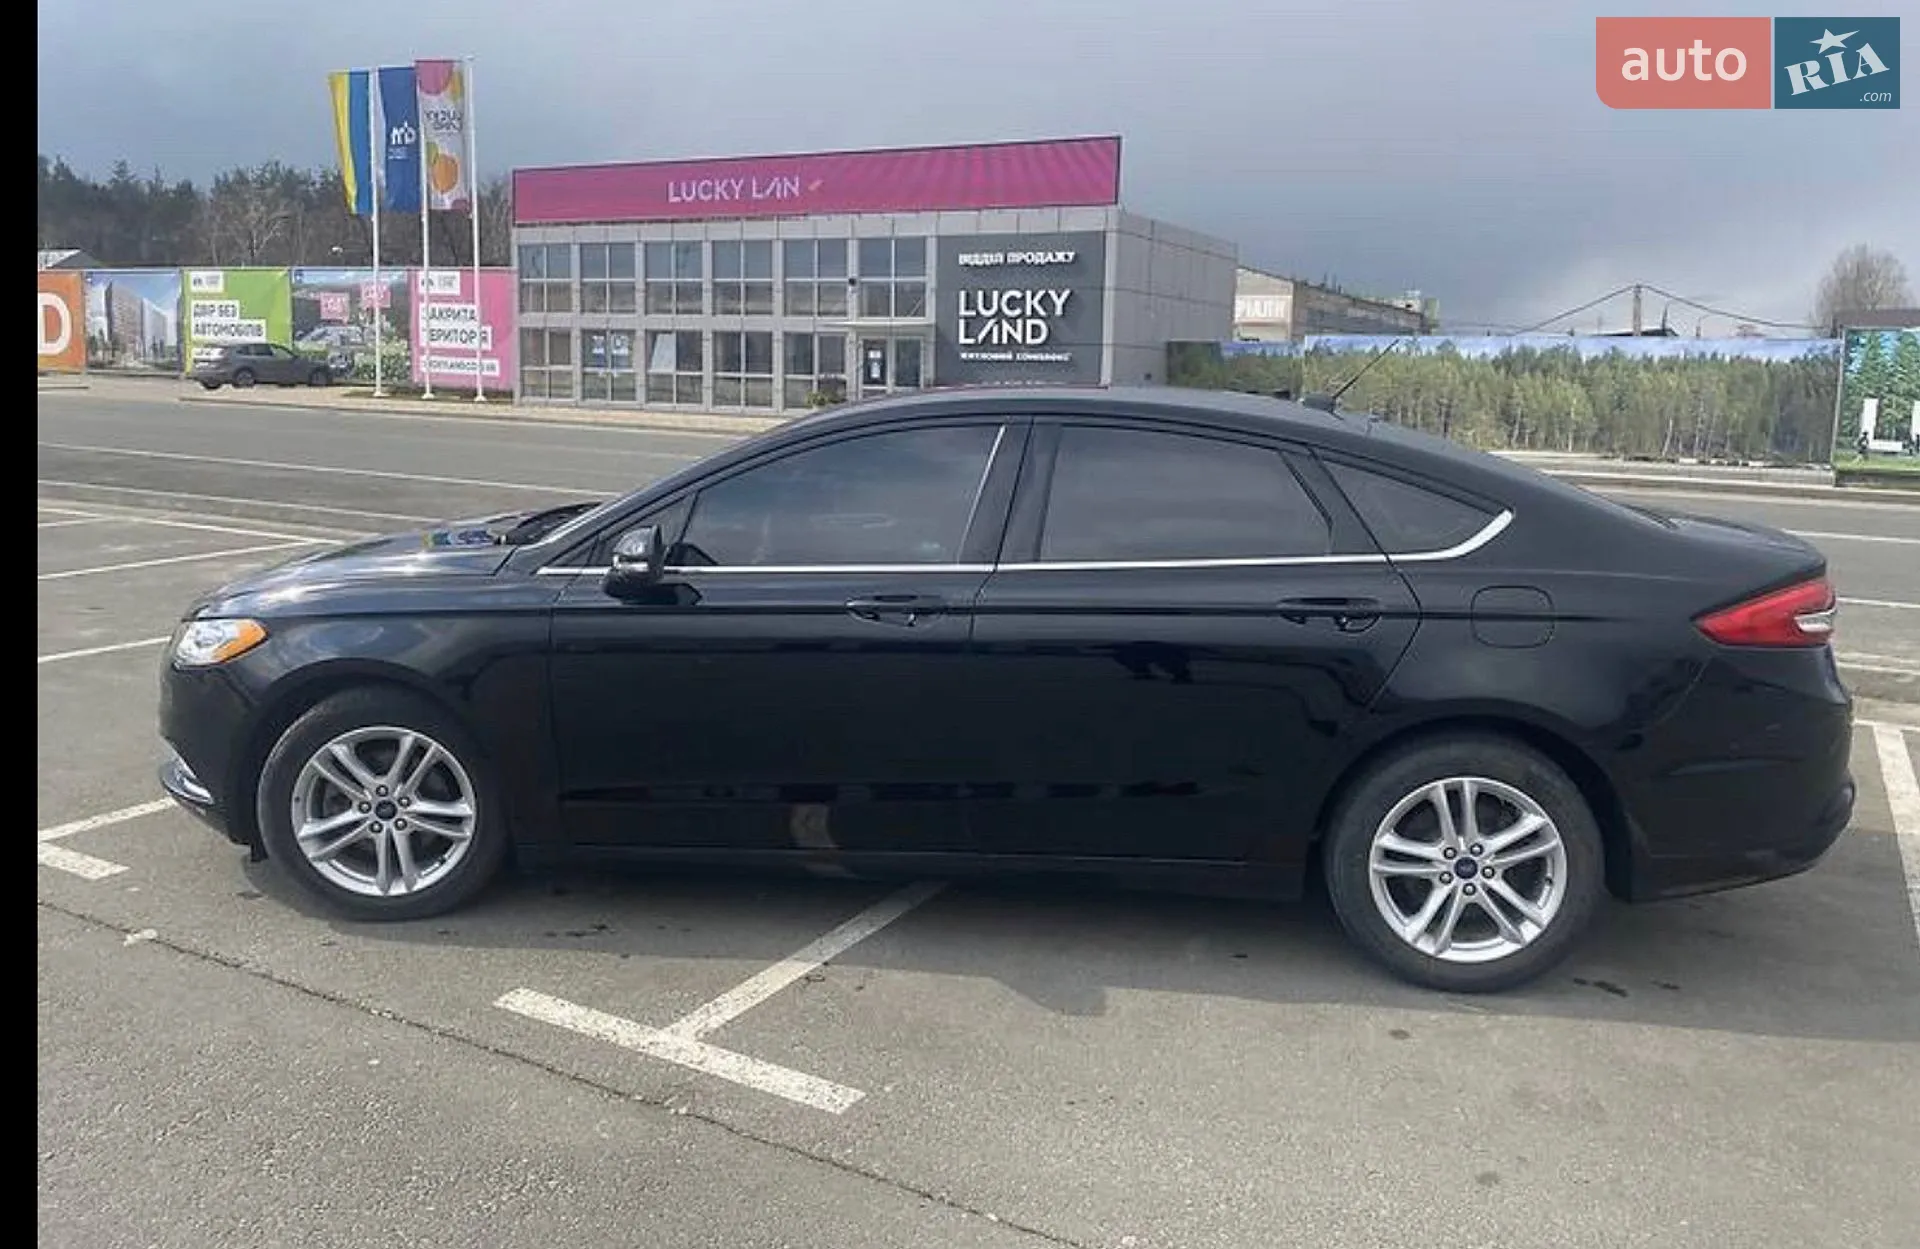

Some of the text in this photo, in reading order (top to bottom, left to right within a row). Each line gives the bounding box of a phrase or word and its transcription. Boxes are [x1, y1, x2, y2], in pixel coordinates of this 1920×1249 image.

[668, 179, 744, 203] LUCKY
[1006, 251, 1076, 265] ПРОДАЖУ
[959, 289, 1071, 317] LUCKY
[959, 318, 1049, 345] LAND
